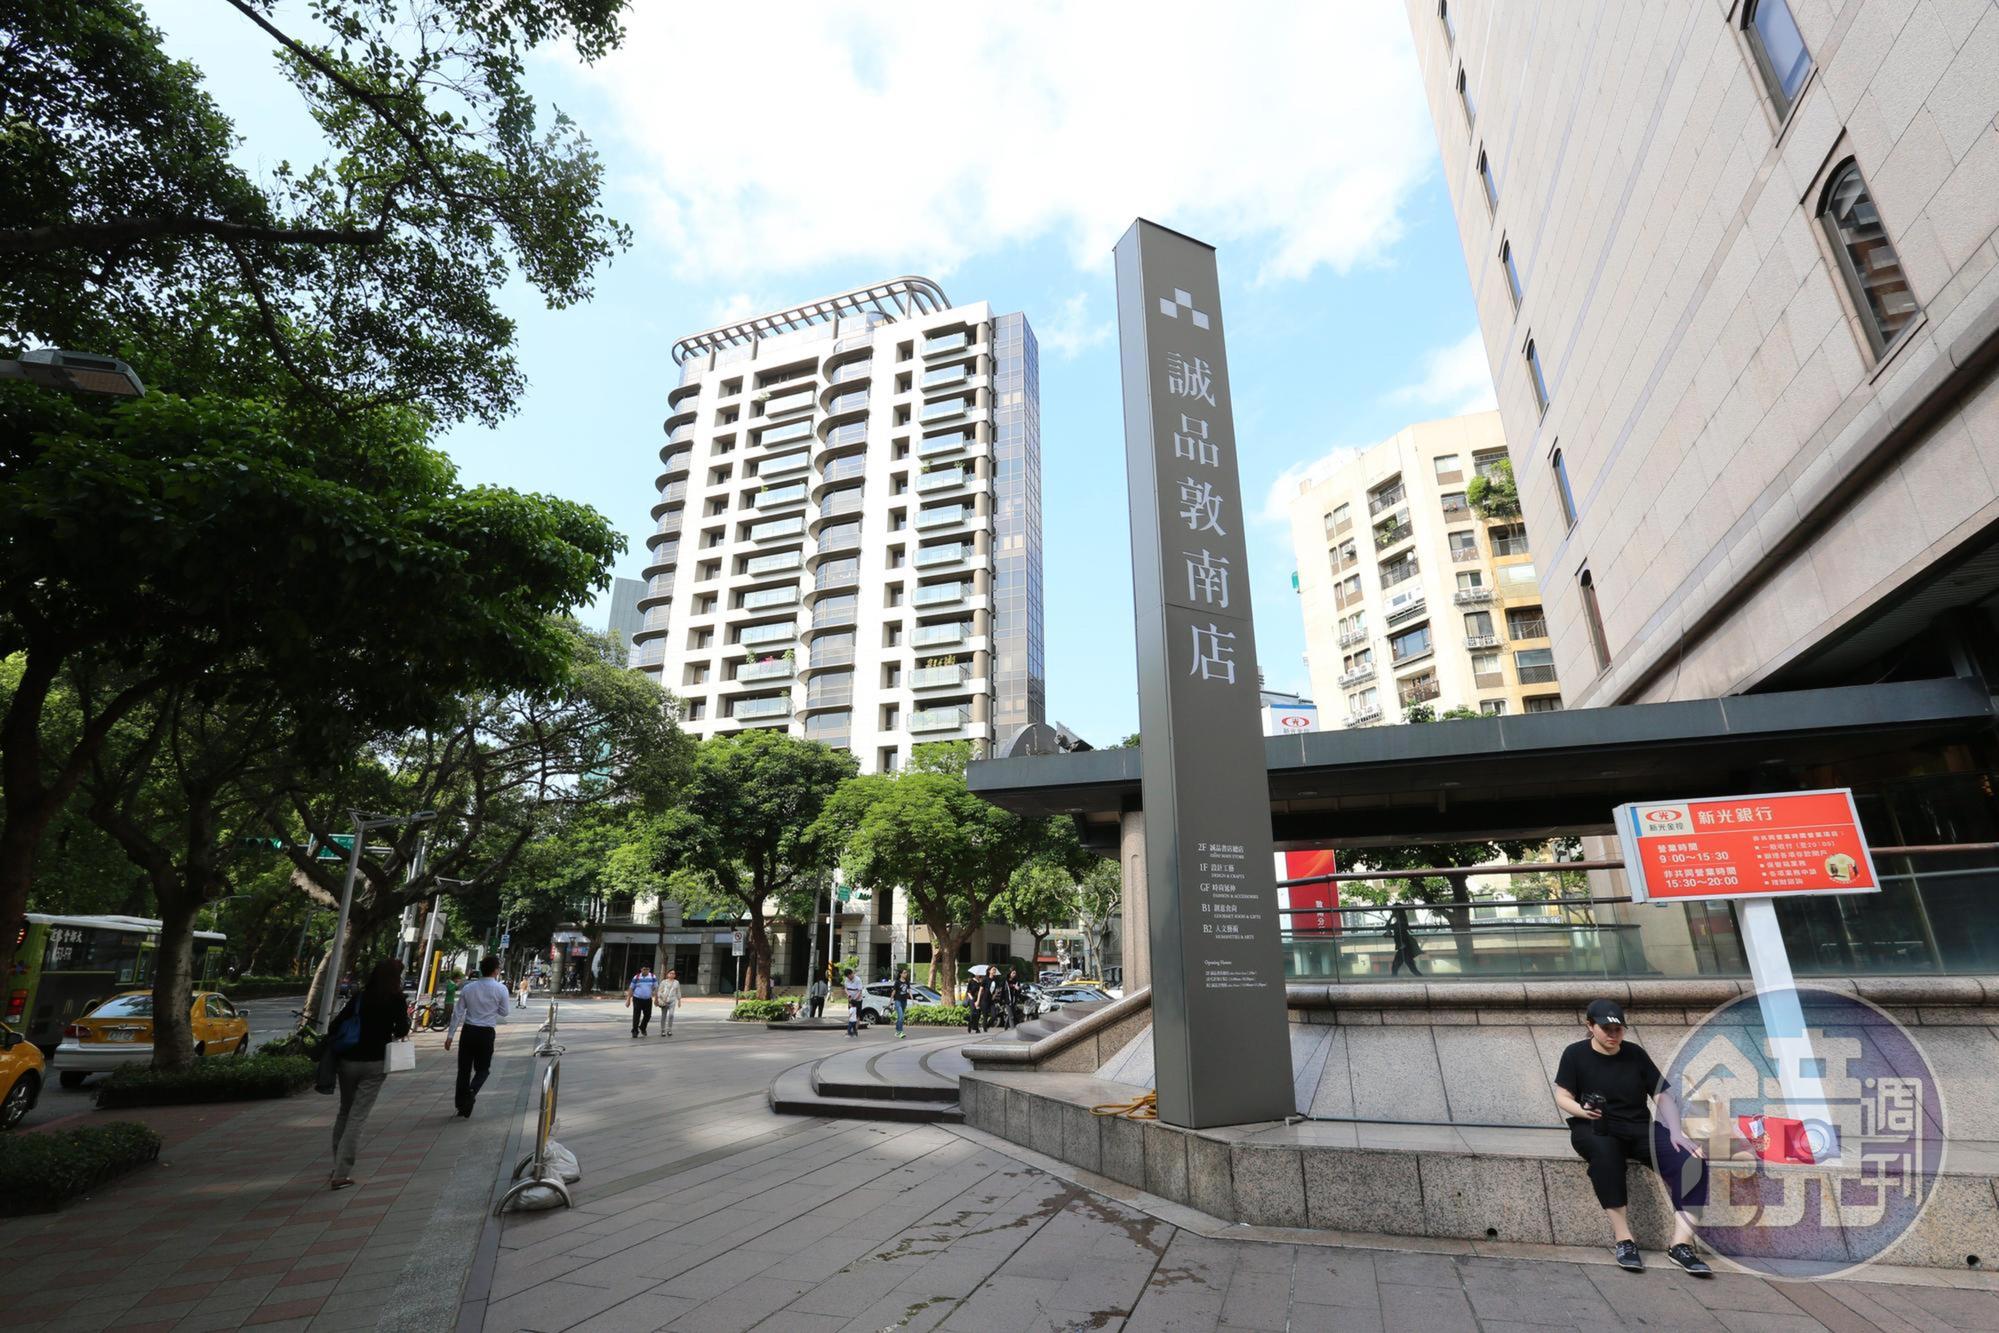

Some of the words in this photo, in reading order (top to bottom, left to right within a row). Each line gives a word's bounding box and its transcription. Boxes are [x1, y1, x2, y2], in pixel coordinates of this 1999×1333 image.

[1167, 351, 1237, 685] 誠品敦南店
[1697, 806, 1773, 825] 新光銀行
[1648, 821, 1684, 832] 新光金控
[1198, 843, 1207, 851] 2F
[1657, 842, 1698, 854] 營業時間
[1200, 863, 1208, 872] 1F
[1663, 865, 1737, 879] 非共同營業時間
[1200, 883, 1210, 892] GF
[1202, 904, 1211, 912] B1
[1203, 924, 1213, 933] B2
